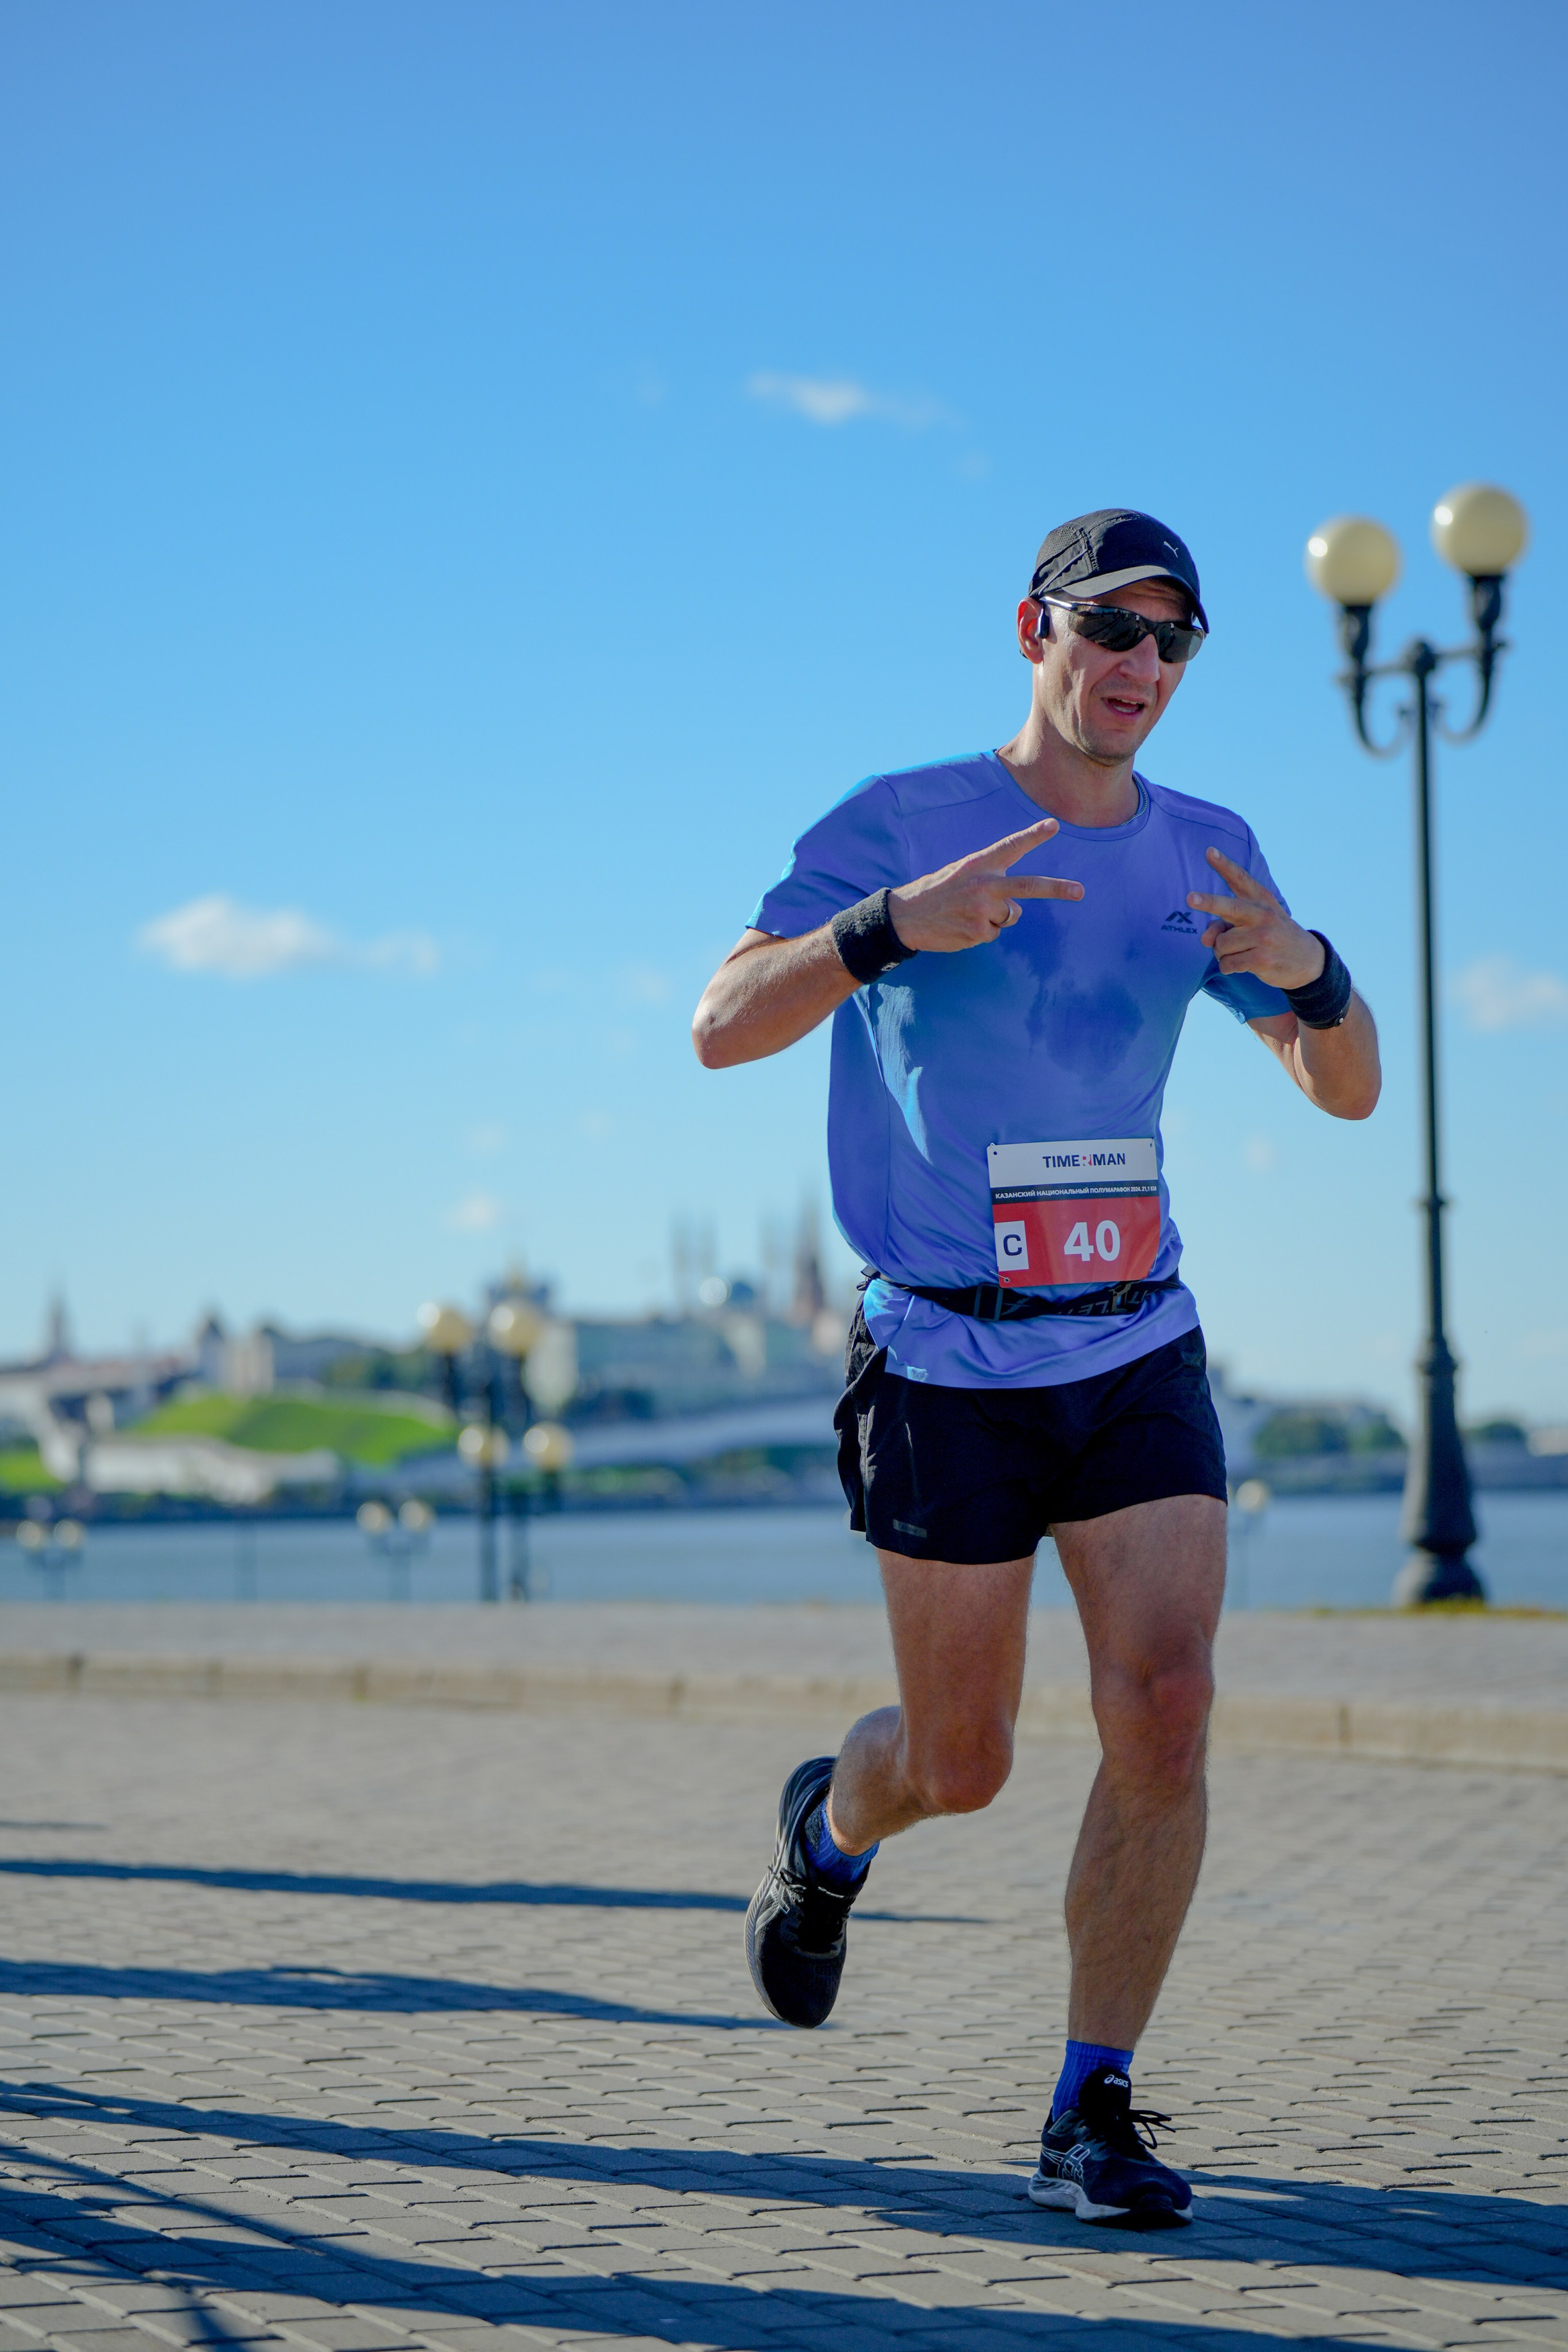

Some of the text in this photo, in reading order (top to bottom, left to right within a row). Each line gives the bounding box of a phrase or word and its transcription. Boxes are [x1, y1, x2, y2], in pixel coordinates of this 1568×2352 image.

[1161, 924, 1197, 934] ATHLEX
[995, 1190, 1036, 1199] КАЗАНСКИЙ
[1036, 1187, 1090, 1196] НАЦИОНАЛЬНЫЙ
[1063, 1219, 1121, 1262] 40
